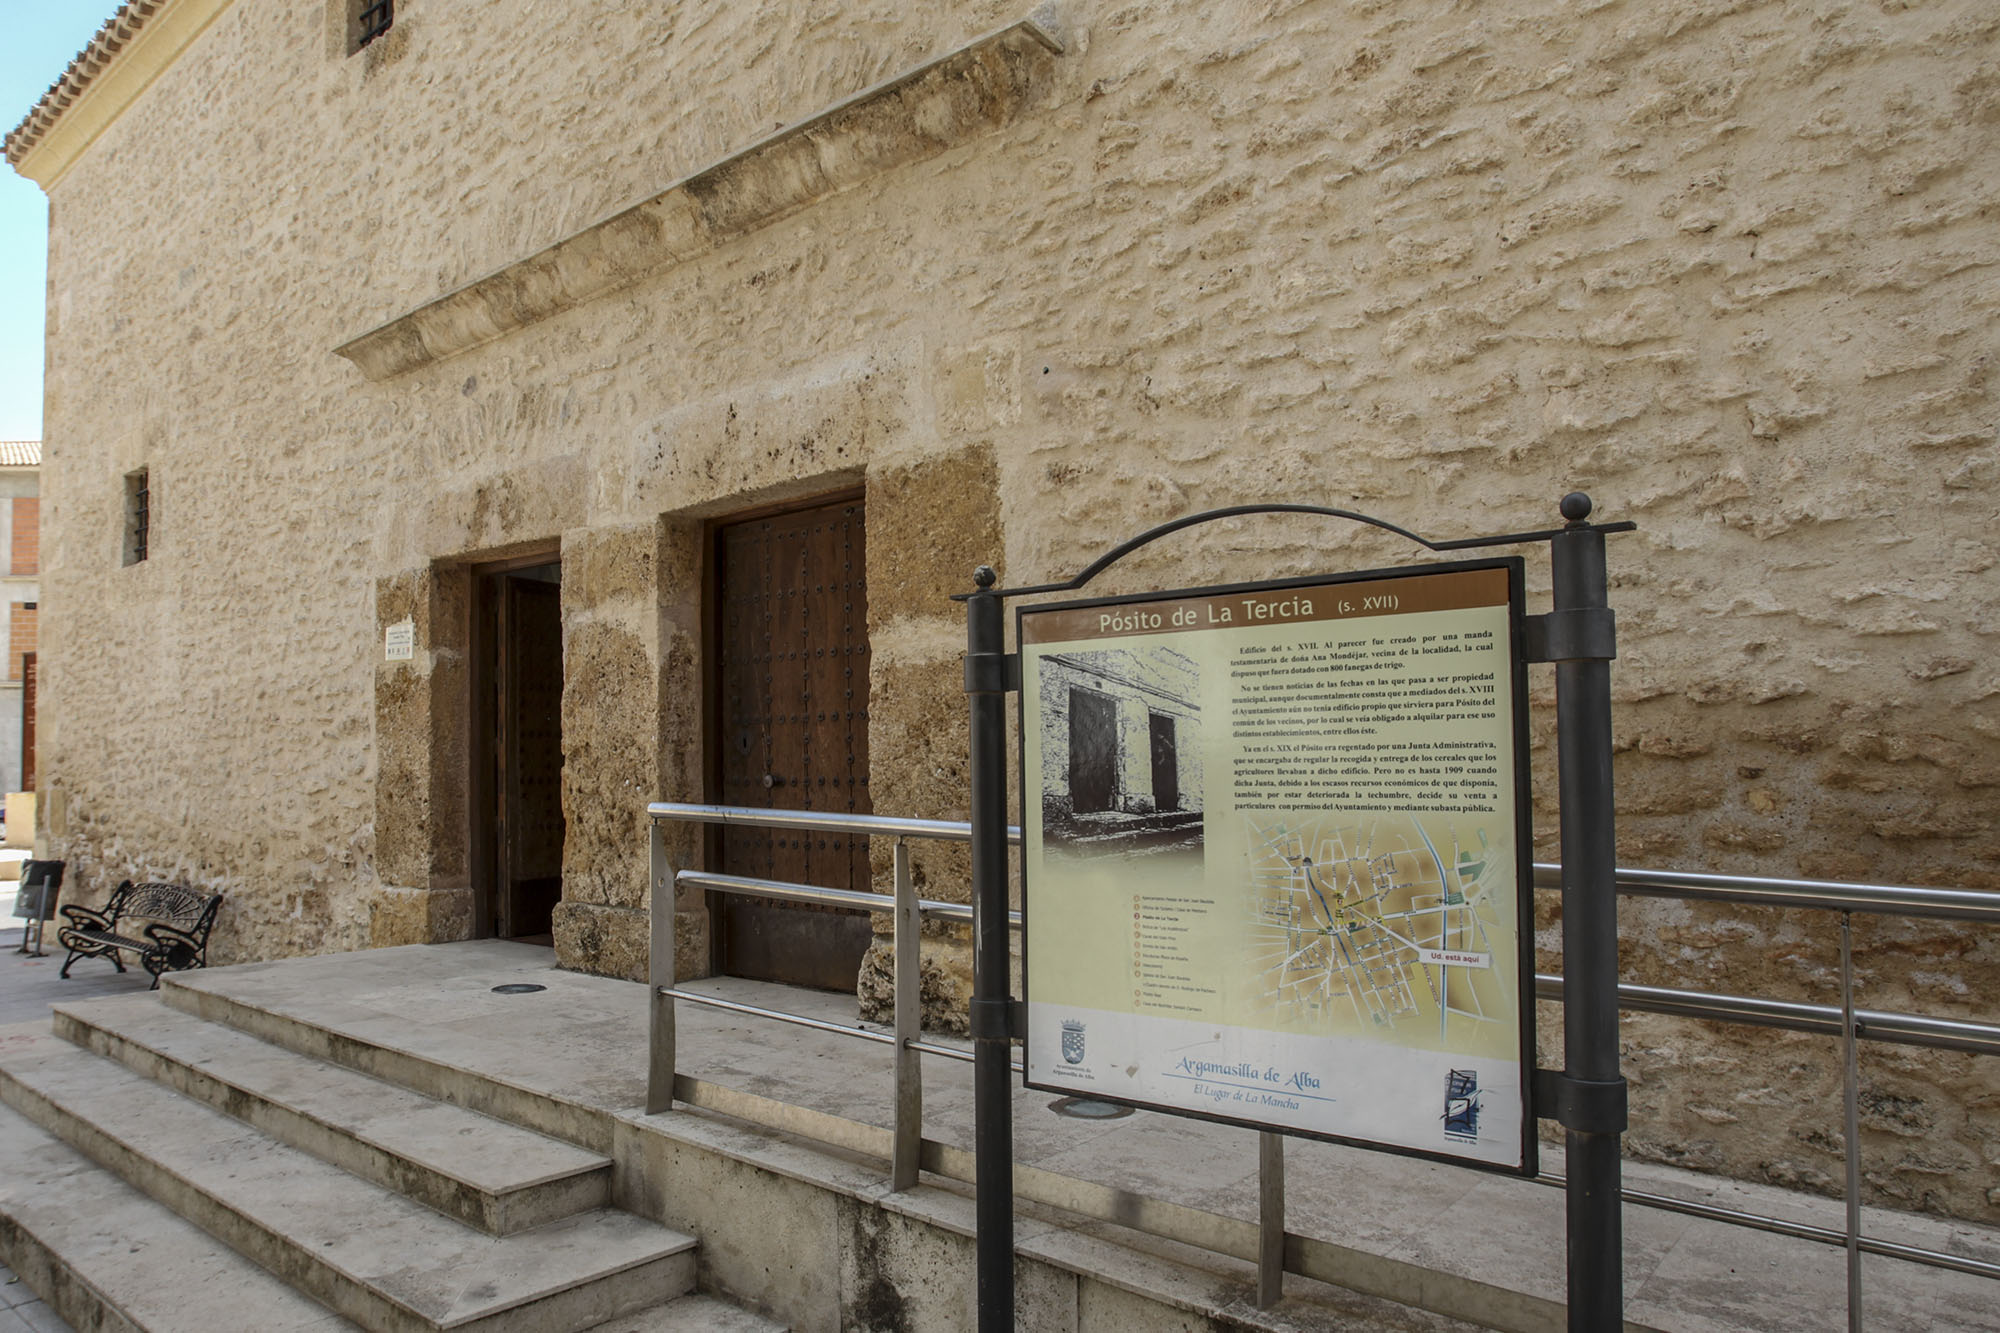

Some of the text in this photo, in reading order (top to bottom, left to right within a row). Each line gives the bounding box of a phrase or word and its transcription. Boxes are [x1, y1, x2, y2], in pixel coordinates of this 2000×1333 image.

[1099, 595, 1399, 633] Pósito de La Tercia (s. XVII)
[1239, 645, 1266, 654] Edificio
[1270, 644, 1282, 652] del
[1324, 640, 1332, 648] Al
[1337, 640, 1366, 649] parecer
[1371, 637, 1384, 645] fue
[1389, 634, 1416, 644] creado
[1422, 635, 1436, 643] por
[1463, 629, 1492, 639] manda
[1229, 656, 1277, 666] testamentaria
[1279, 655, 1288, 663] de
[1311, 653, 1326, 661] Ana
[1329, 650, 1368, 661] Mondéjar,
[1371, 649, 1395, 657] vecina
[1398, 647, 1408, 655] de
[1422, 644, 1461, 655] localidad,
[1464, 643, 1472, 651] la
[1475, 642, 1493, 651] cual
[1270, 667, 1289, 675] fuera
[1290, 665, 1315, 673] dotado
[1329, 663, 1343, 671] 800
[1344, 662, 1372, 672] fanegas
[1373, 661, 1383, 669] de
[1383, 660, 1405, 670] trigo.
[1285, 681, 1313, 689] noticias
[1315, 680, 1324, 688] de
[1339, 678, 1363, 687] fechas
[1377, 677, 1388, 685] las
[1390, 678, 1405, 686] que
[1408, 677, 1426, 685] pasa
[1451, 672, 1494, 683] propiedad
[1231, 695, 1267, 705] municipal,
[1268, 695, 1294, 703] aunque
[1295, 690, 1360, 700] documentalmente
[1386, 690, 1401, 698] que
[1408, 686, 1446, 695] mediados
[1447, 686, 1460, 694] del
[1469, 684, 1494, 693] XVIII
[1239, 705, 1287, 716] Ayuntamiento
[1332, 703, 1360, 711] edificio
[1360, 702, 1386, 712] propio
[1387, 703, 1402, 711] que
[1403, 700, 1433, 708] sirviera
[1434, 701, 1454, 709] para
[1455, 698, 1481, 706] Pósito
[1482, 697, 1495, 705] del
[1277, 717, 1305, 725] vecinos,
[1328, 715, 1344, 723] cual
[1371, 713, 1405, 723] obligado
[1412, 712, 1444, 722] alquilar
[1445, 713, 1465, 721] para
[1232, 729, 1261, 737] distintos
[1261, 728, 1322, 737] establecimientos,
[1360, 726, 1377, 734] éste.
[1300, 743, 1323, 751] Pósito
[1337, 742, 1375, 752] regentado
[1407, 741, 1430, 749] Junta
[1432, 740, 1496, 749] Administrativa,
[1255, 756, 1291, 765] encargaba
[1303, 755, 1329, 764] regular
[1339, 754, 1371, 764] recogida
[1379, 754, 1408, 763] entrega
[1421, 753, 1432, 761] los
[1433, 753, 1466, 761] cereales
[1484, 752, 1496, 760] los
[1233, 768, 1274, 776] agricultores
[1373, 766, 1391, 774] Pero
[1466, 765, 1497, 773] cuando
[1383, 778, 1429, 786] económicos
[1430, 778, 1440, 786] de
[1442, 780, 1457, 788] que
[1306, 790, 1349, 798] deteriorada
[1367, 791, 1411, 799] techumbre,
[1234, 801, 1275, 810] particulares
[1291, 802, 1321, 811] permiso
[1334, 802, 1387, 812] Ayuntamiento
[1430, 803, 1461, 811] subasta
[1462, 803, 1495, 813] pública.
[1431, 952, 1443, 960] Ud.
[1175, 1056, 1321, 1091] Argamasilla de Alba
[1194, 1083, 1300, 1111] El Lugar de La Mancha
